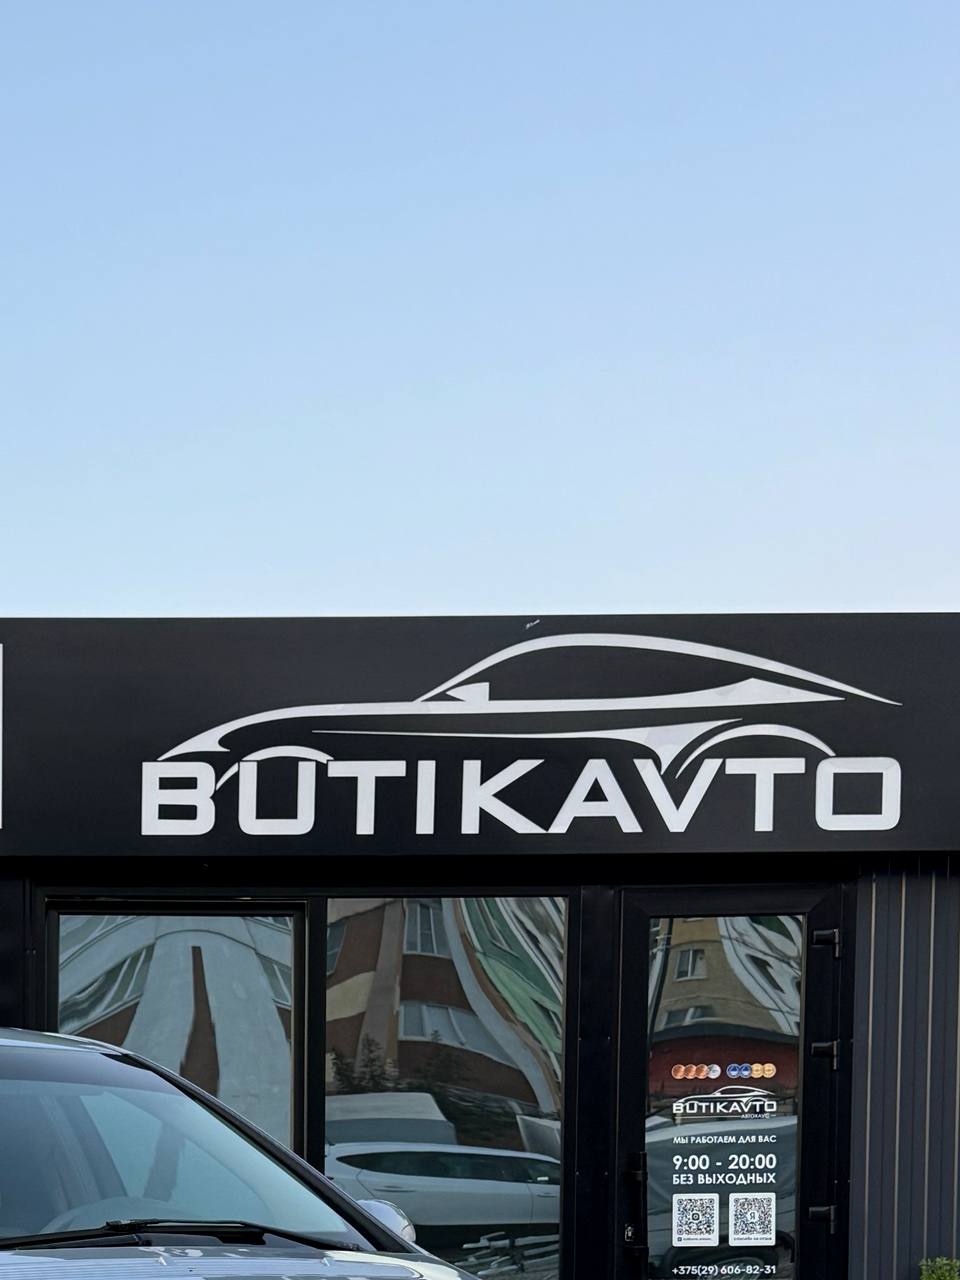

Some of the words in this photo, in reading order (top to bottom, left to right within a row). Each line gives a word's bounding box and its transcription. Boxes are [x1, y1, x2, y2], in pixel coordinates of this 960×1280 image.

[141, 757, 902, 835] BUTIKAVTO
[673, 1102, 777, 1113] BUTIKAVTO
[673, 1136, 688, 1144] МЫ
[690, 1136, 737, 1144] РАБОТАЕМ
[673, 1155, 709, 1170] 9:00
[728, 1154, 776, 1169] 20:00
[673, 1174, 693, 1184] БЕЗ
[698, 1173, 775, 1184] ВЫХОДНЫХ
[672, 1265, 718, 1276] +375(29)
[721, 1265, 777, 1275] 606-82-31
